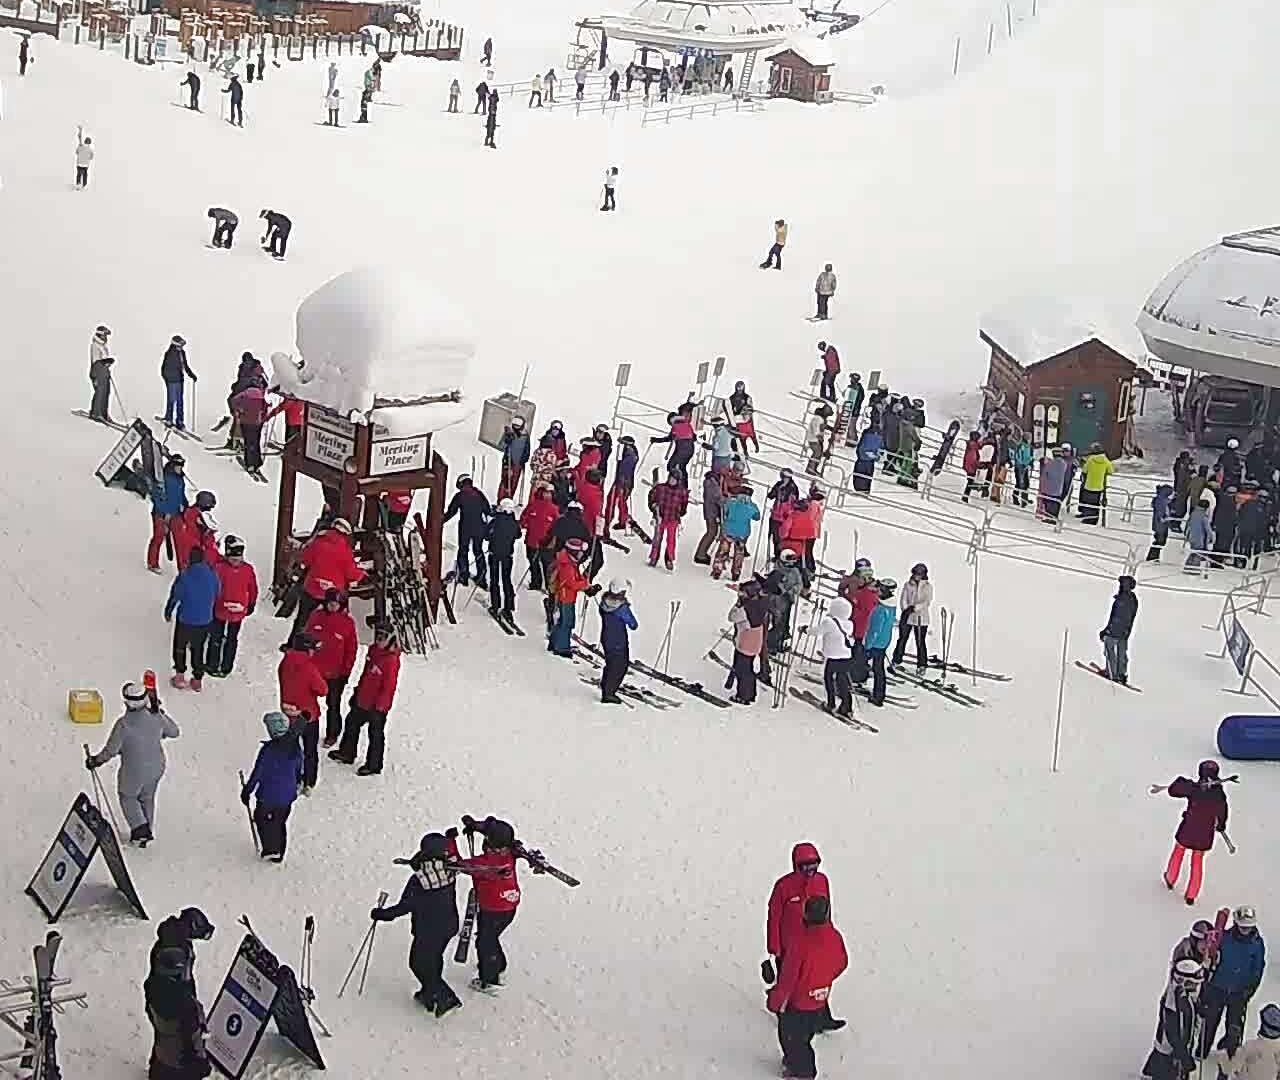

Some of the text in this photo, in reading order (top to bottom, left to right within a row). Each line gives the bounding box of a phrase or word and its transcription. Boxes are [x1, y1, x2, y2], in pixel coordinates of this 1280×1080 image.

[313, 431, 348, 454] Meeting
[380, 442, 420, 457] Meeting
[317, 444, 343, 462] Place
[383, 454, 414, 467] Place
